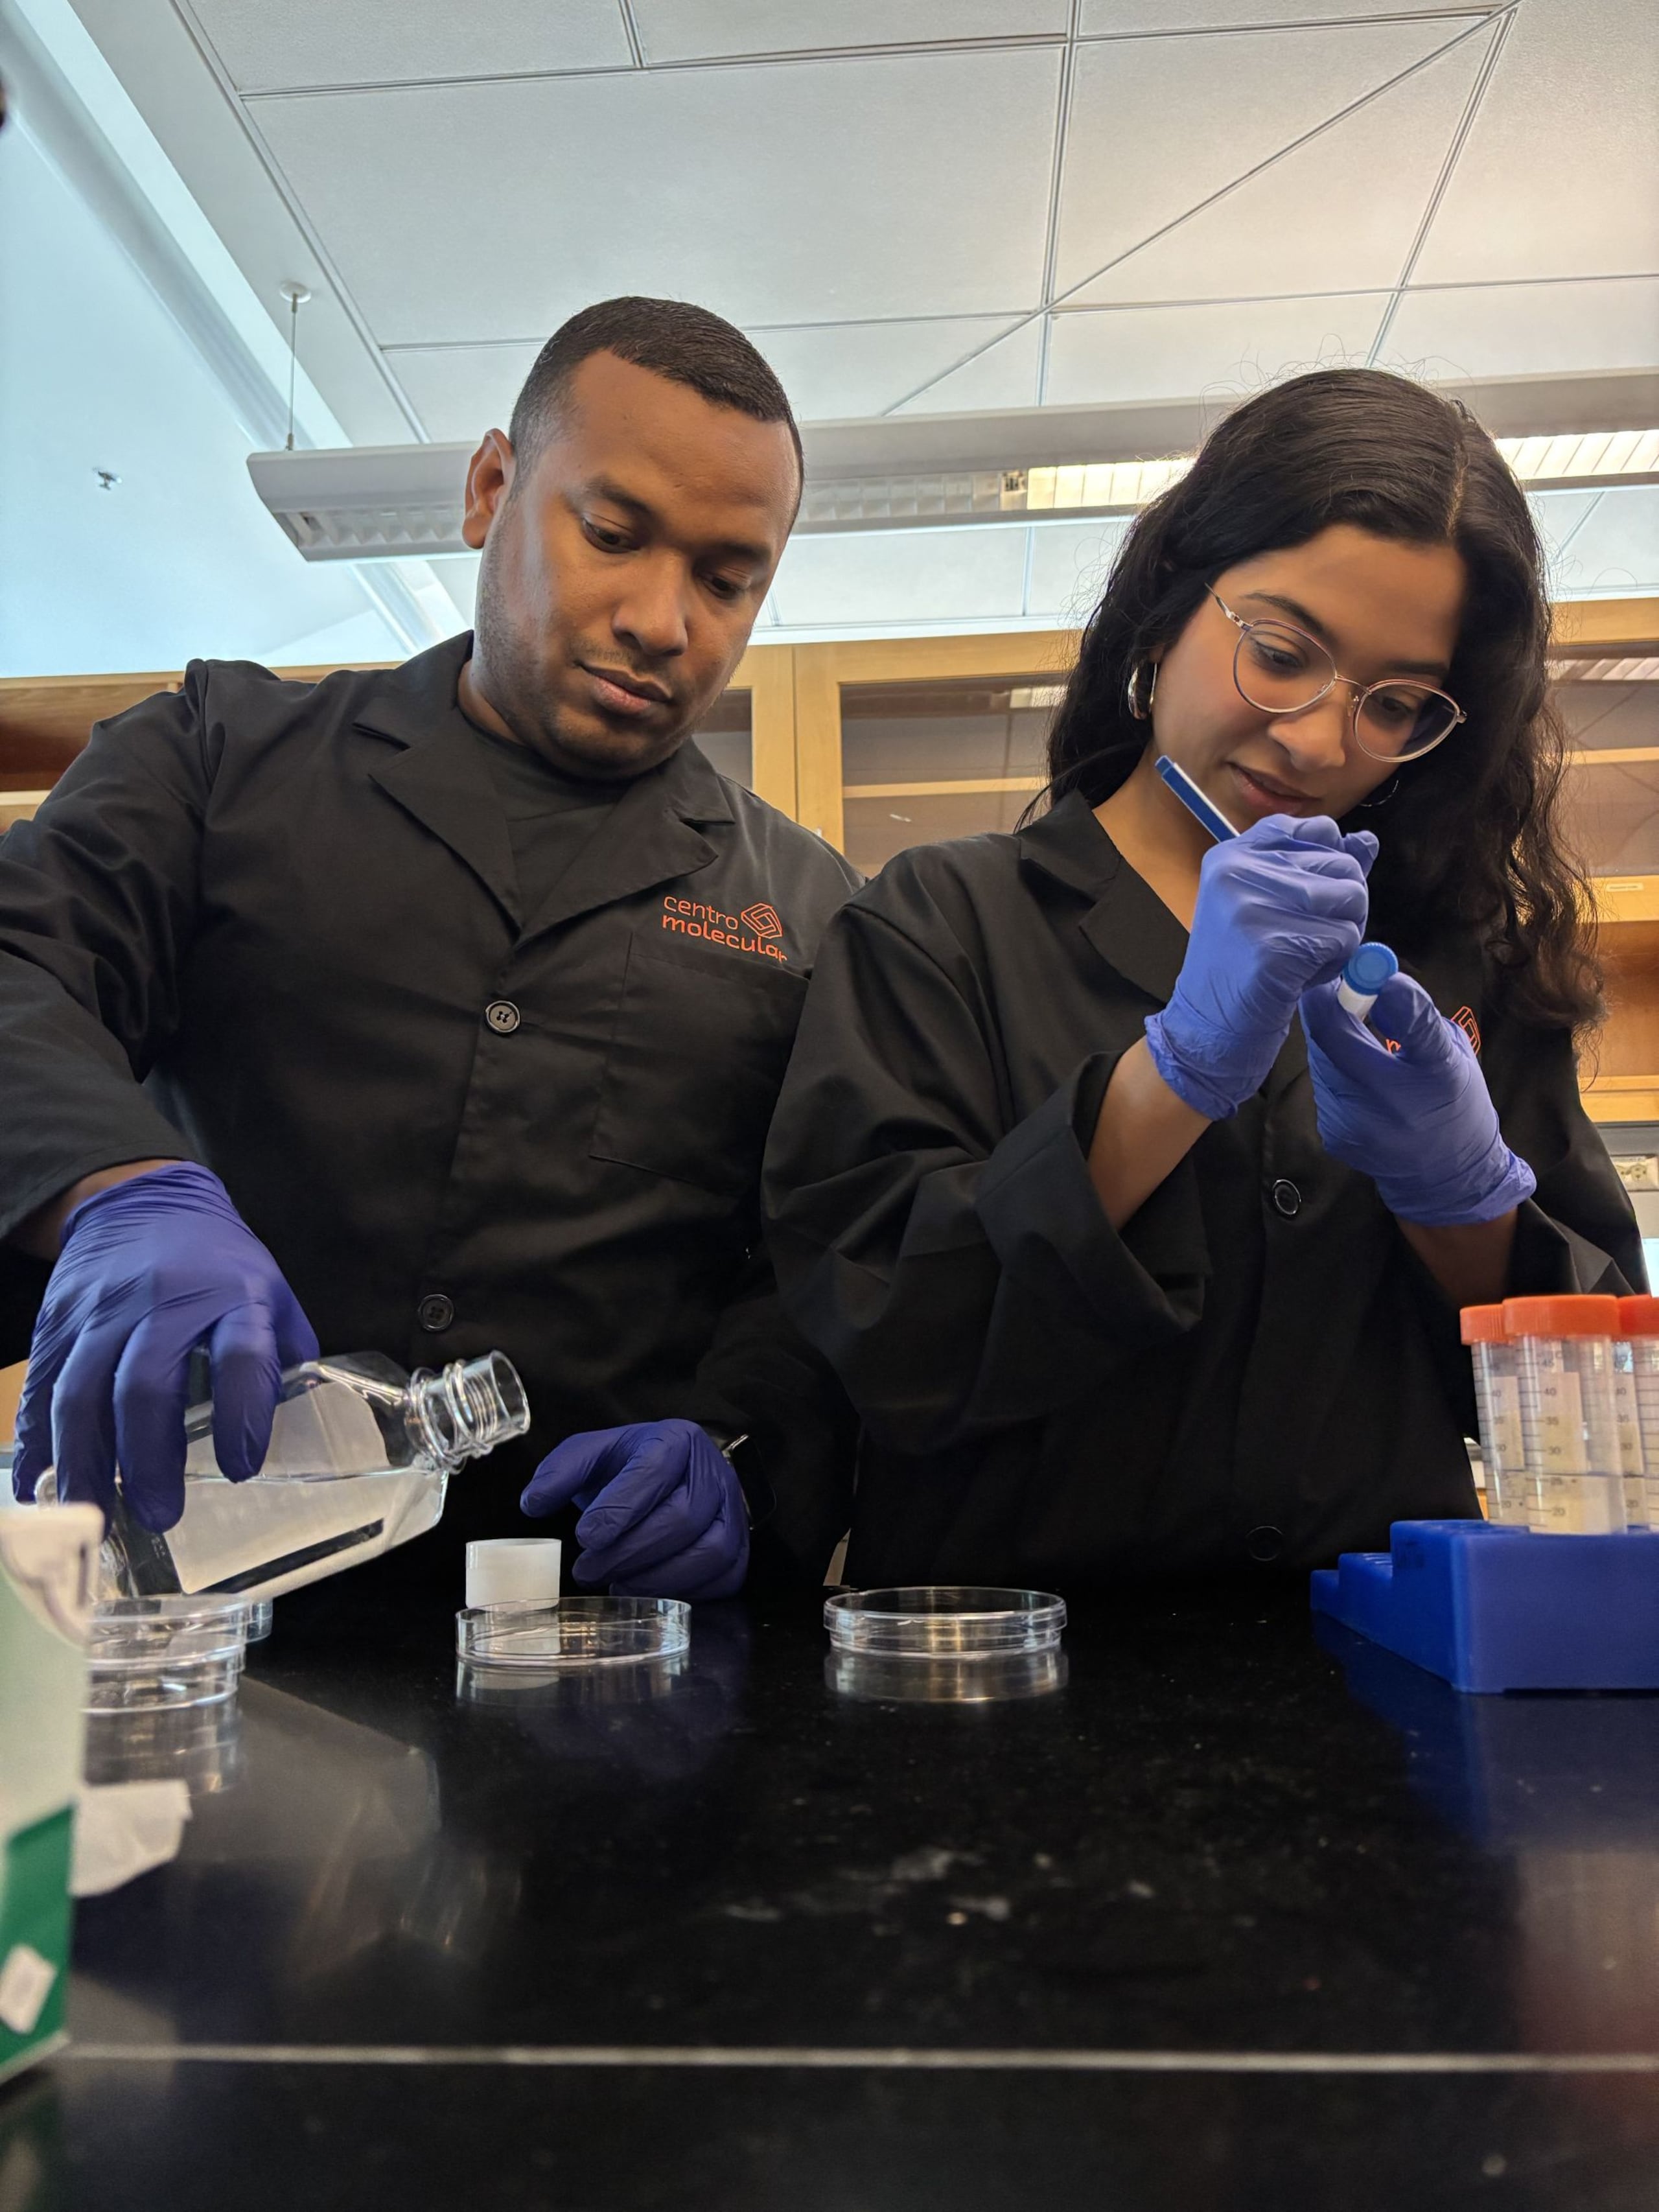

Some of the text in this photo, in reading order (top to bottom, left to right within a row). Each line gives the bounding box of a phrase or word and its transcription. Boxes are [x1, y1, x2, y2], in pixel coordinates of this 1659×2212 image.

[664, 896, 739, 930] centro
[662, 914, 787, 963] molecular
[1544, 1387, 1557, 1396] 40
